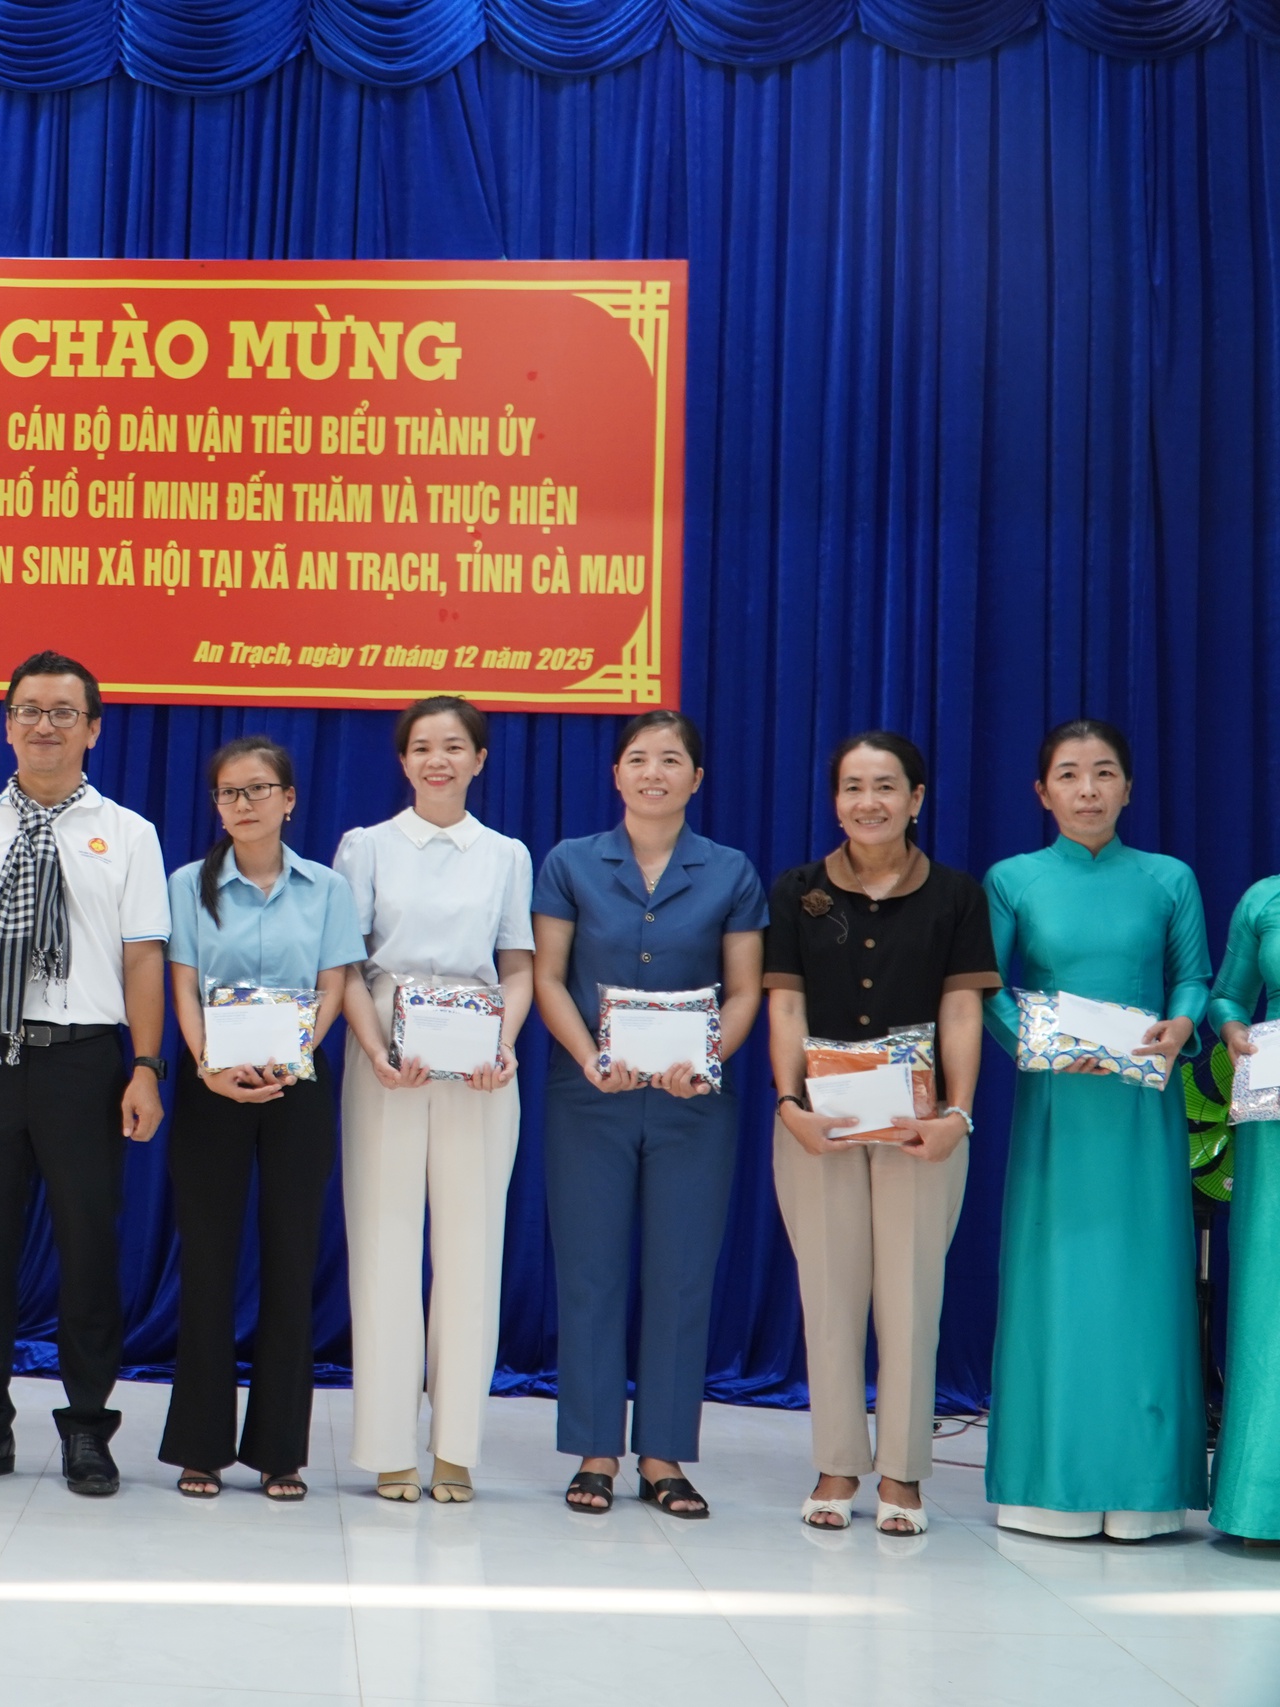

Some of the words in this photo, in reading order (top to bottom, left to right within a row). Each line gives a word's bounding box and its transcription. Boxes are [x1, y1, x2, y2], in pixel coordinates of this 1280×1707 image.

[0, 303, 208, 379] CHÀO
[228, 305, 462, 381] MỪNG
[8, 404, 65, 451] CÁN
[74, 405, 111, 460] BỘ
[120, 406, 177, 452] DÂN
[186, 406, 242, 462] VẬN
[252, 407, 312, 454] TIÊU
[321, 399, 386, 455] BIỂU
[395, 408, 489, 456] THÀNH
[498, 403, 537, 456] ỦY
[42, 466, 80, 518] HỒ
[88, 472, 135, 519] CHÍ
[144, 481, 218, 520] MINH
[226, 470, 283, 521] ĐẾN
[293, 475, 372, 523] THĂM
[381, 475, 418, 523] VÀ
[427, 481, 501, 533] THỰC
[509, 477, 577, 535] HIỆN
[22, 546, 89, 585] SINH
[97, 539, 135, 586] XÃ
[144, 540, 190, 596] HỘI
[198, 549, 242, 597] TẠI
[251, 542, 289, 589] XÃ
[297, 551, 338, 590] AN
[347, 551, 448, 601] TRẠCH,
[456, 539, 522, 594] TỈNH
[532, 545, 571, 594] CÀ
[579, 554, 646, 595] MAU
[193, 640, 225, 663] An
[229, 641, 293, 668] Trạch,
[298, 643, 355, 668] ngày
[358, 644, 382, 667] 17
[384, 644, 449, 671] tháng
[454, 645, 480, 668] 12
[481, 646, 533, 670] năm
[535, 647, 595, 671] 2025
